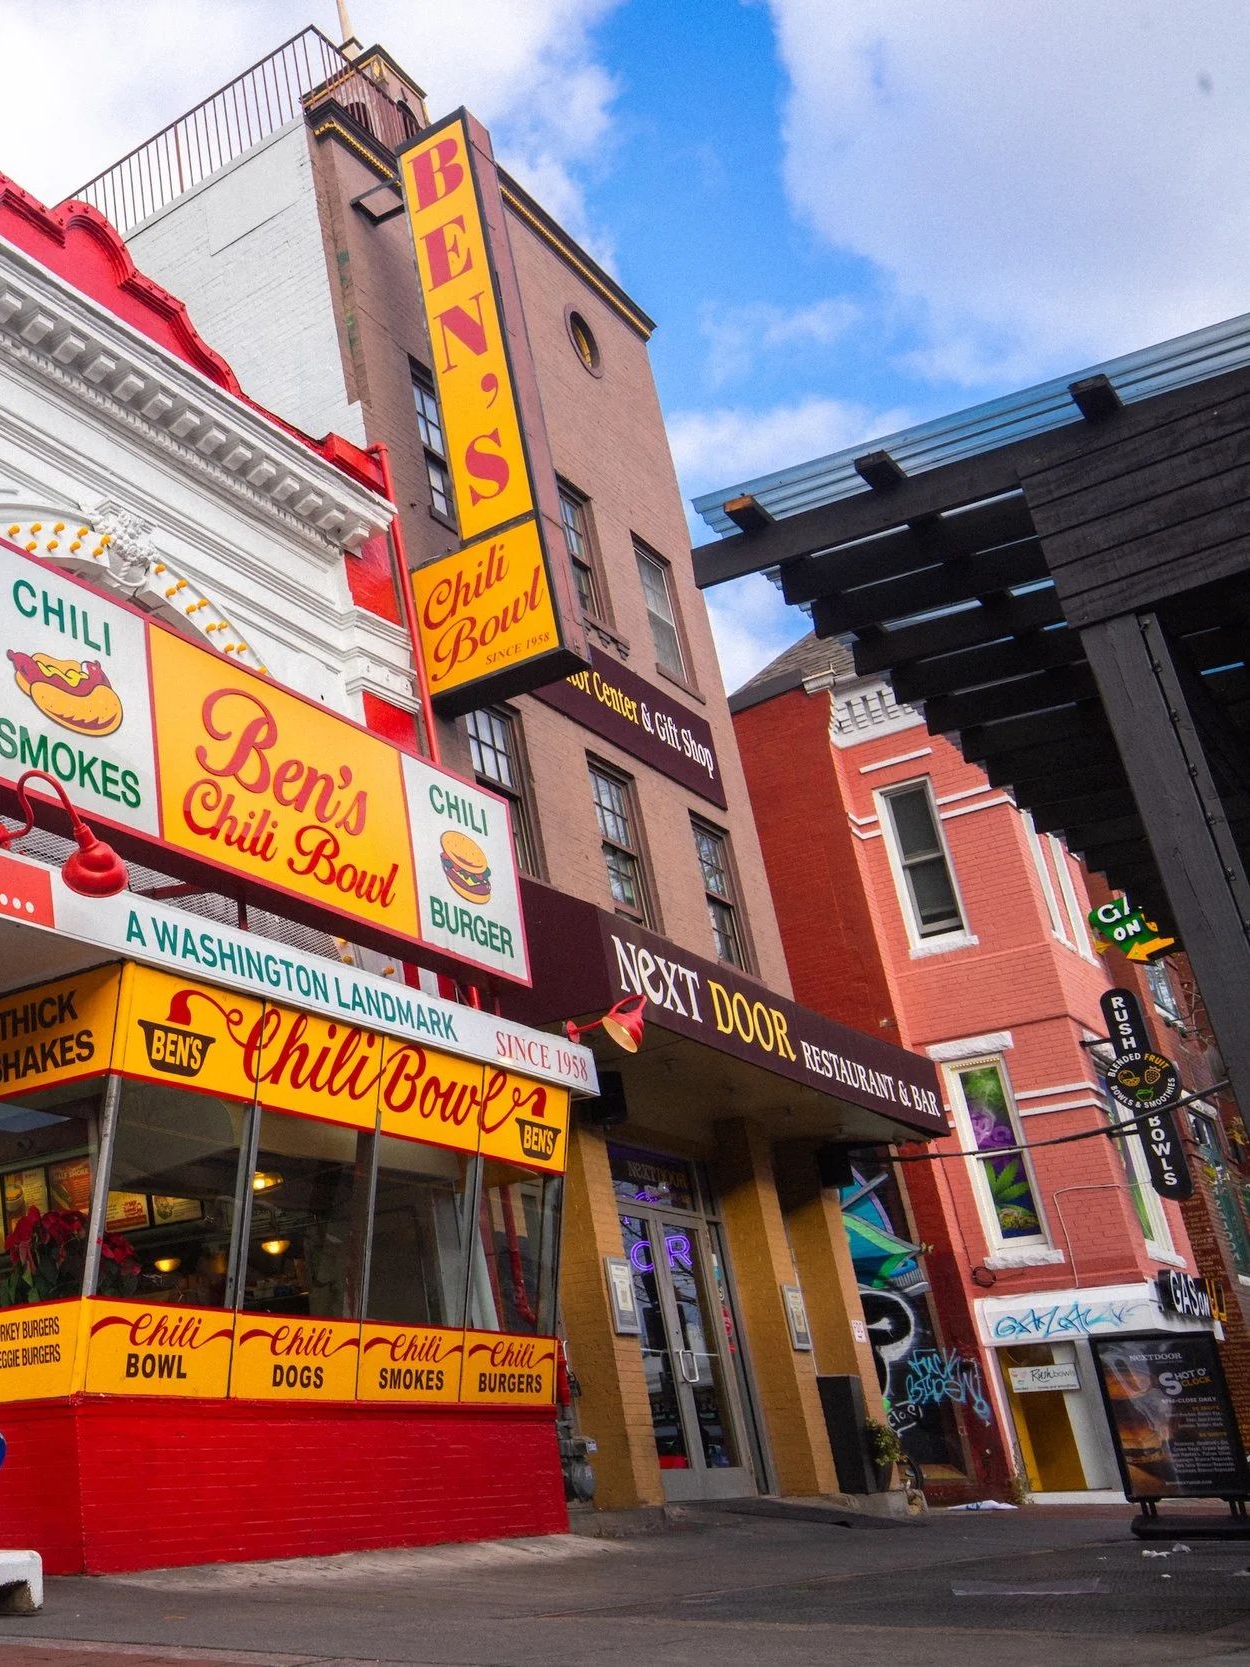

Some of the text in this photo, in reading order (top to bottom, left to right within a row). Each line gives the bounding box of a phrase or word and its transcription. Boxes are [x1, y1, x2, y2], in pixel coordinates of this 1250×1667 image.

[407, 137, 510, 507] BEN'S
[422, 543, 508, 631] Chili
[11, 578, 111, 657] CHILI
[430, 566, 544, 682] Bowl
[485, 631, 552, 667] SINCE 1958
[593, 671, 639, 725] Center
[640, 702, 654, 735] &
[655, 711, 681, 751] Gift
[681, 728, 715, 780] Shop
[194, 687, 369, 836] Ben's
[428, 783, 489, 837] CHILI
[182, 780, 400, 910] Chili Bowl
[430, 894, 516, 960] BURGER
[1113, 919, 1141, 941] ON
[125, 910, 589, 1083] A WASHINGTON LANDMARK SINCE 1958
[1111, 996, 1137, 1050] RUSH
[151, 1028, 203, 1067] BEN'S
[708, 979, 797, 1062] DOOR
[800, 1040, 897, 1103] RESTAURANT
[898, 1079, 912, 1109] &
[912, 1087, 941, 1118] BAR
[1107, 1052, 1170, 1078] BLENDED FRUIT
[240, 1008, 520, 1134] Chili Bowl
[1110, 1077, 1176, 1109] BOWLS & SMOOTHIES
[524, 1127, 555, 1154] BEN'S
[1149, 1116, 1178, 1186] BOWLS
[21, 1316, 60, 1338] BURGERS
[129, 1313, 201, 1348] Chili
[268, 1325, 332, 1358] Chili
[21, 1344, 61, 1366] BURGERS
[389, 1333, 444, 1362] Chili
[490, 1341, 538, 1367] Chili
[125, 1352, 187, 1380] BOWL
[272, 1363, 324, 1389] DOGS
[378, 1367, 444, 1391] SMOKES
[478, 1372, 543, 1394] BURGERS
[1181, 1376, 1212, 1388] CLOCK
